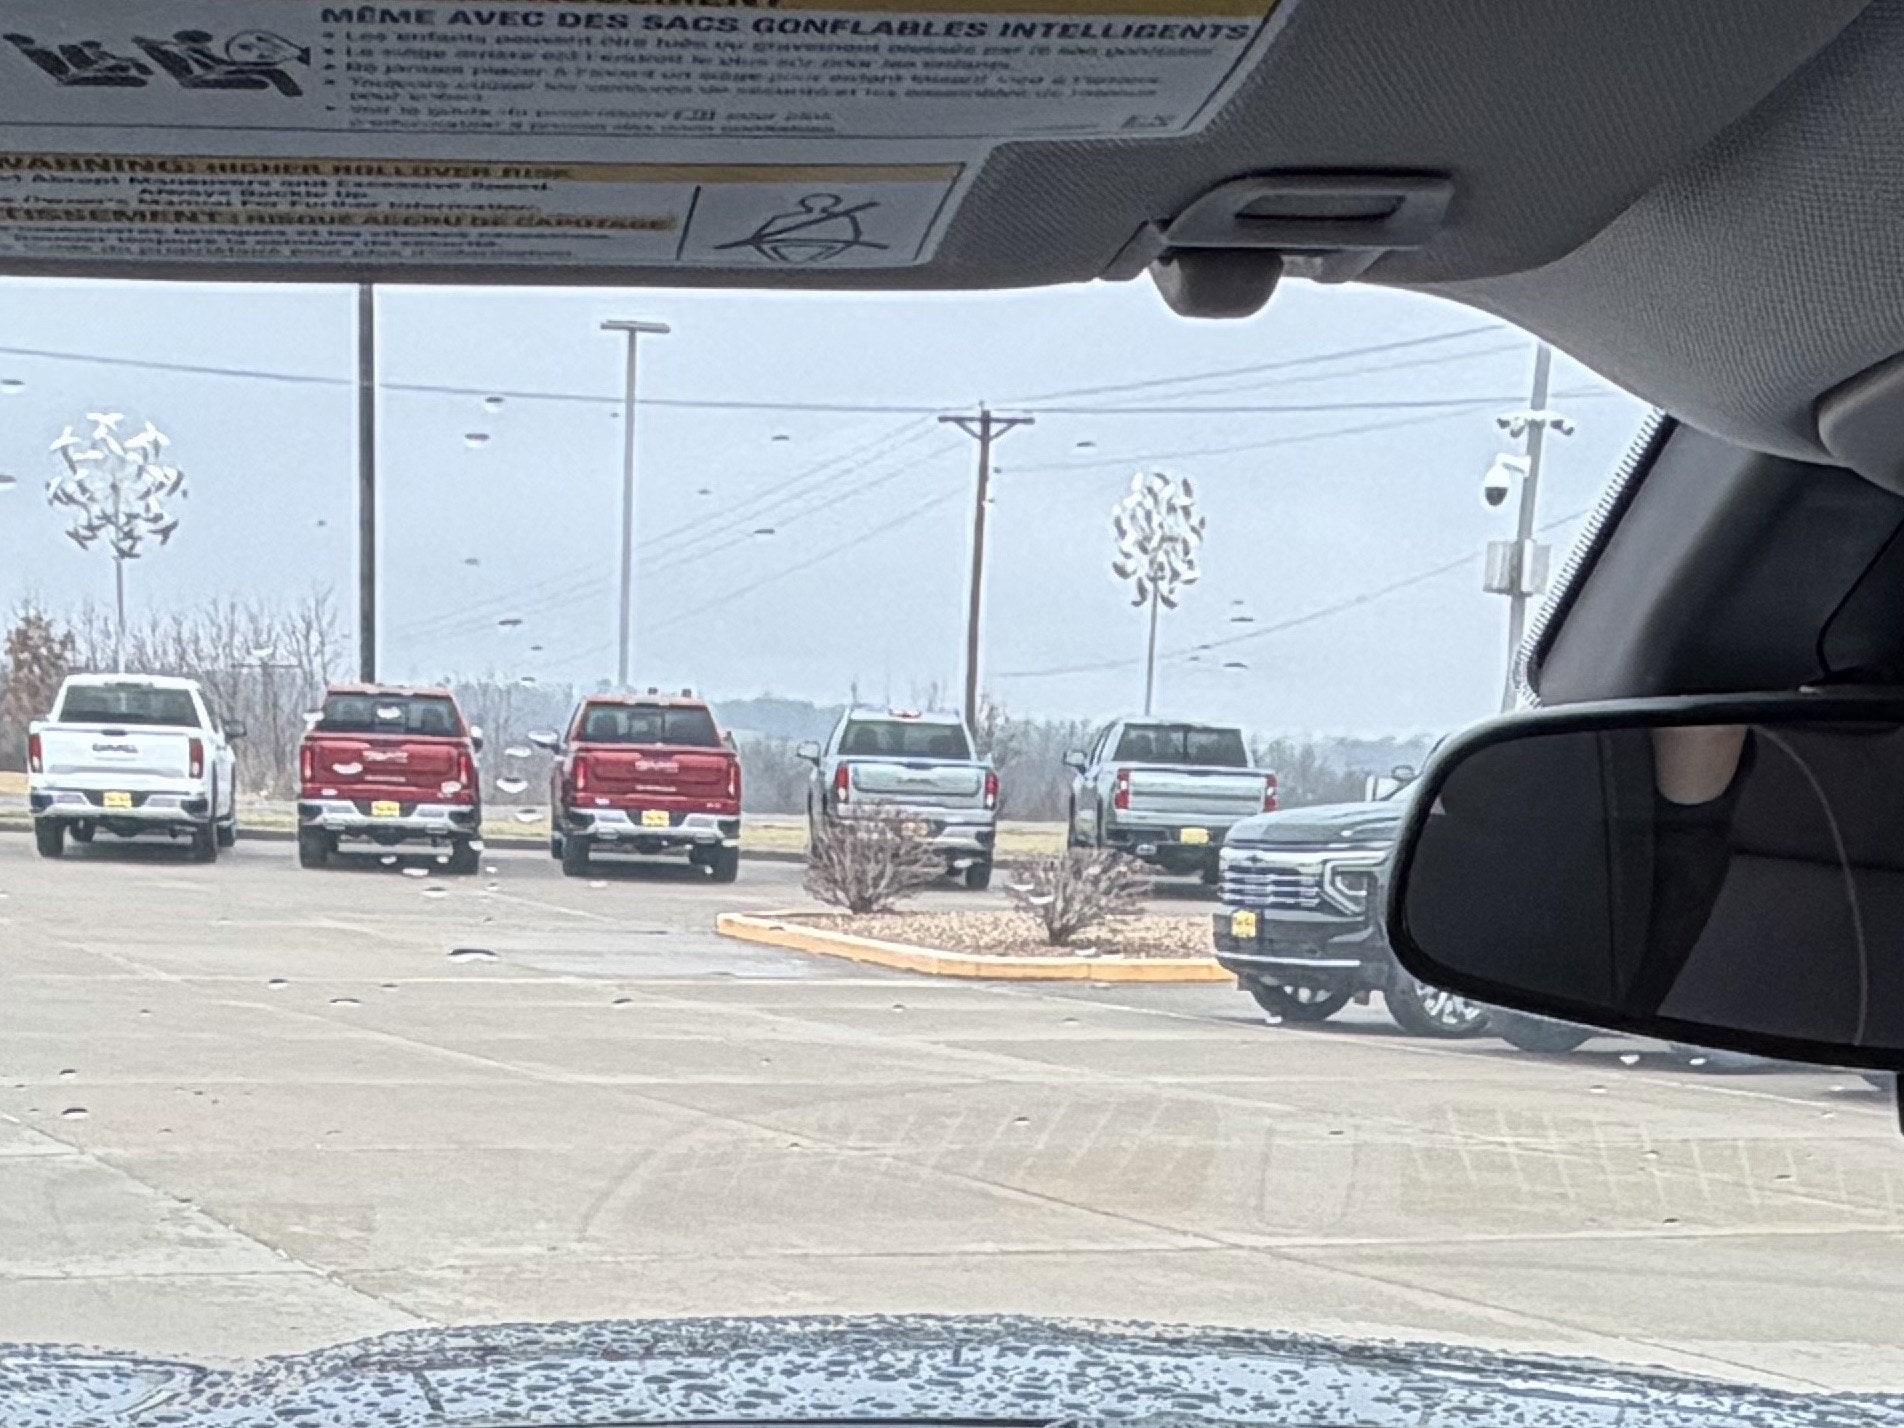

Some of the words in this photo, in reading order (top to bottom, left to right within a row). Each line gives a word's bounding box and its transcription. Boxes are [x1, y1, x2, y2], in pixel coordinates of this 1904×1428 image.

[321, 6, 436, 25] MÊME
[448, 9, 545, 27] AVEC
[557, 12, 631, 30] DES
[642, 14, 740, 33] SACS
[752, 16, 988, 39] GONFLABLES
[998, 22, 1248, 40] INTELLIGENTS
